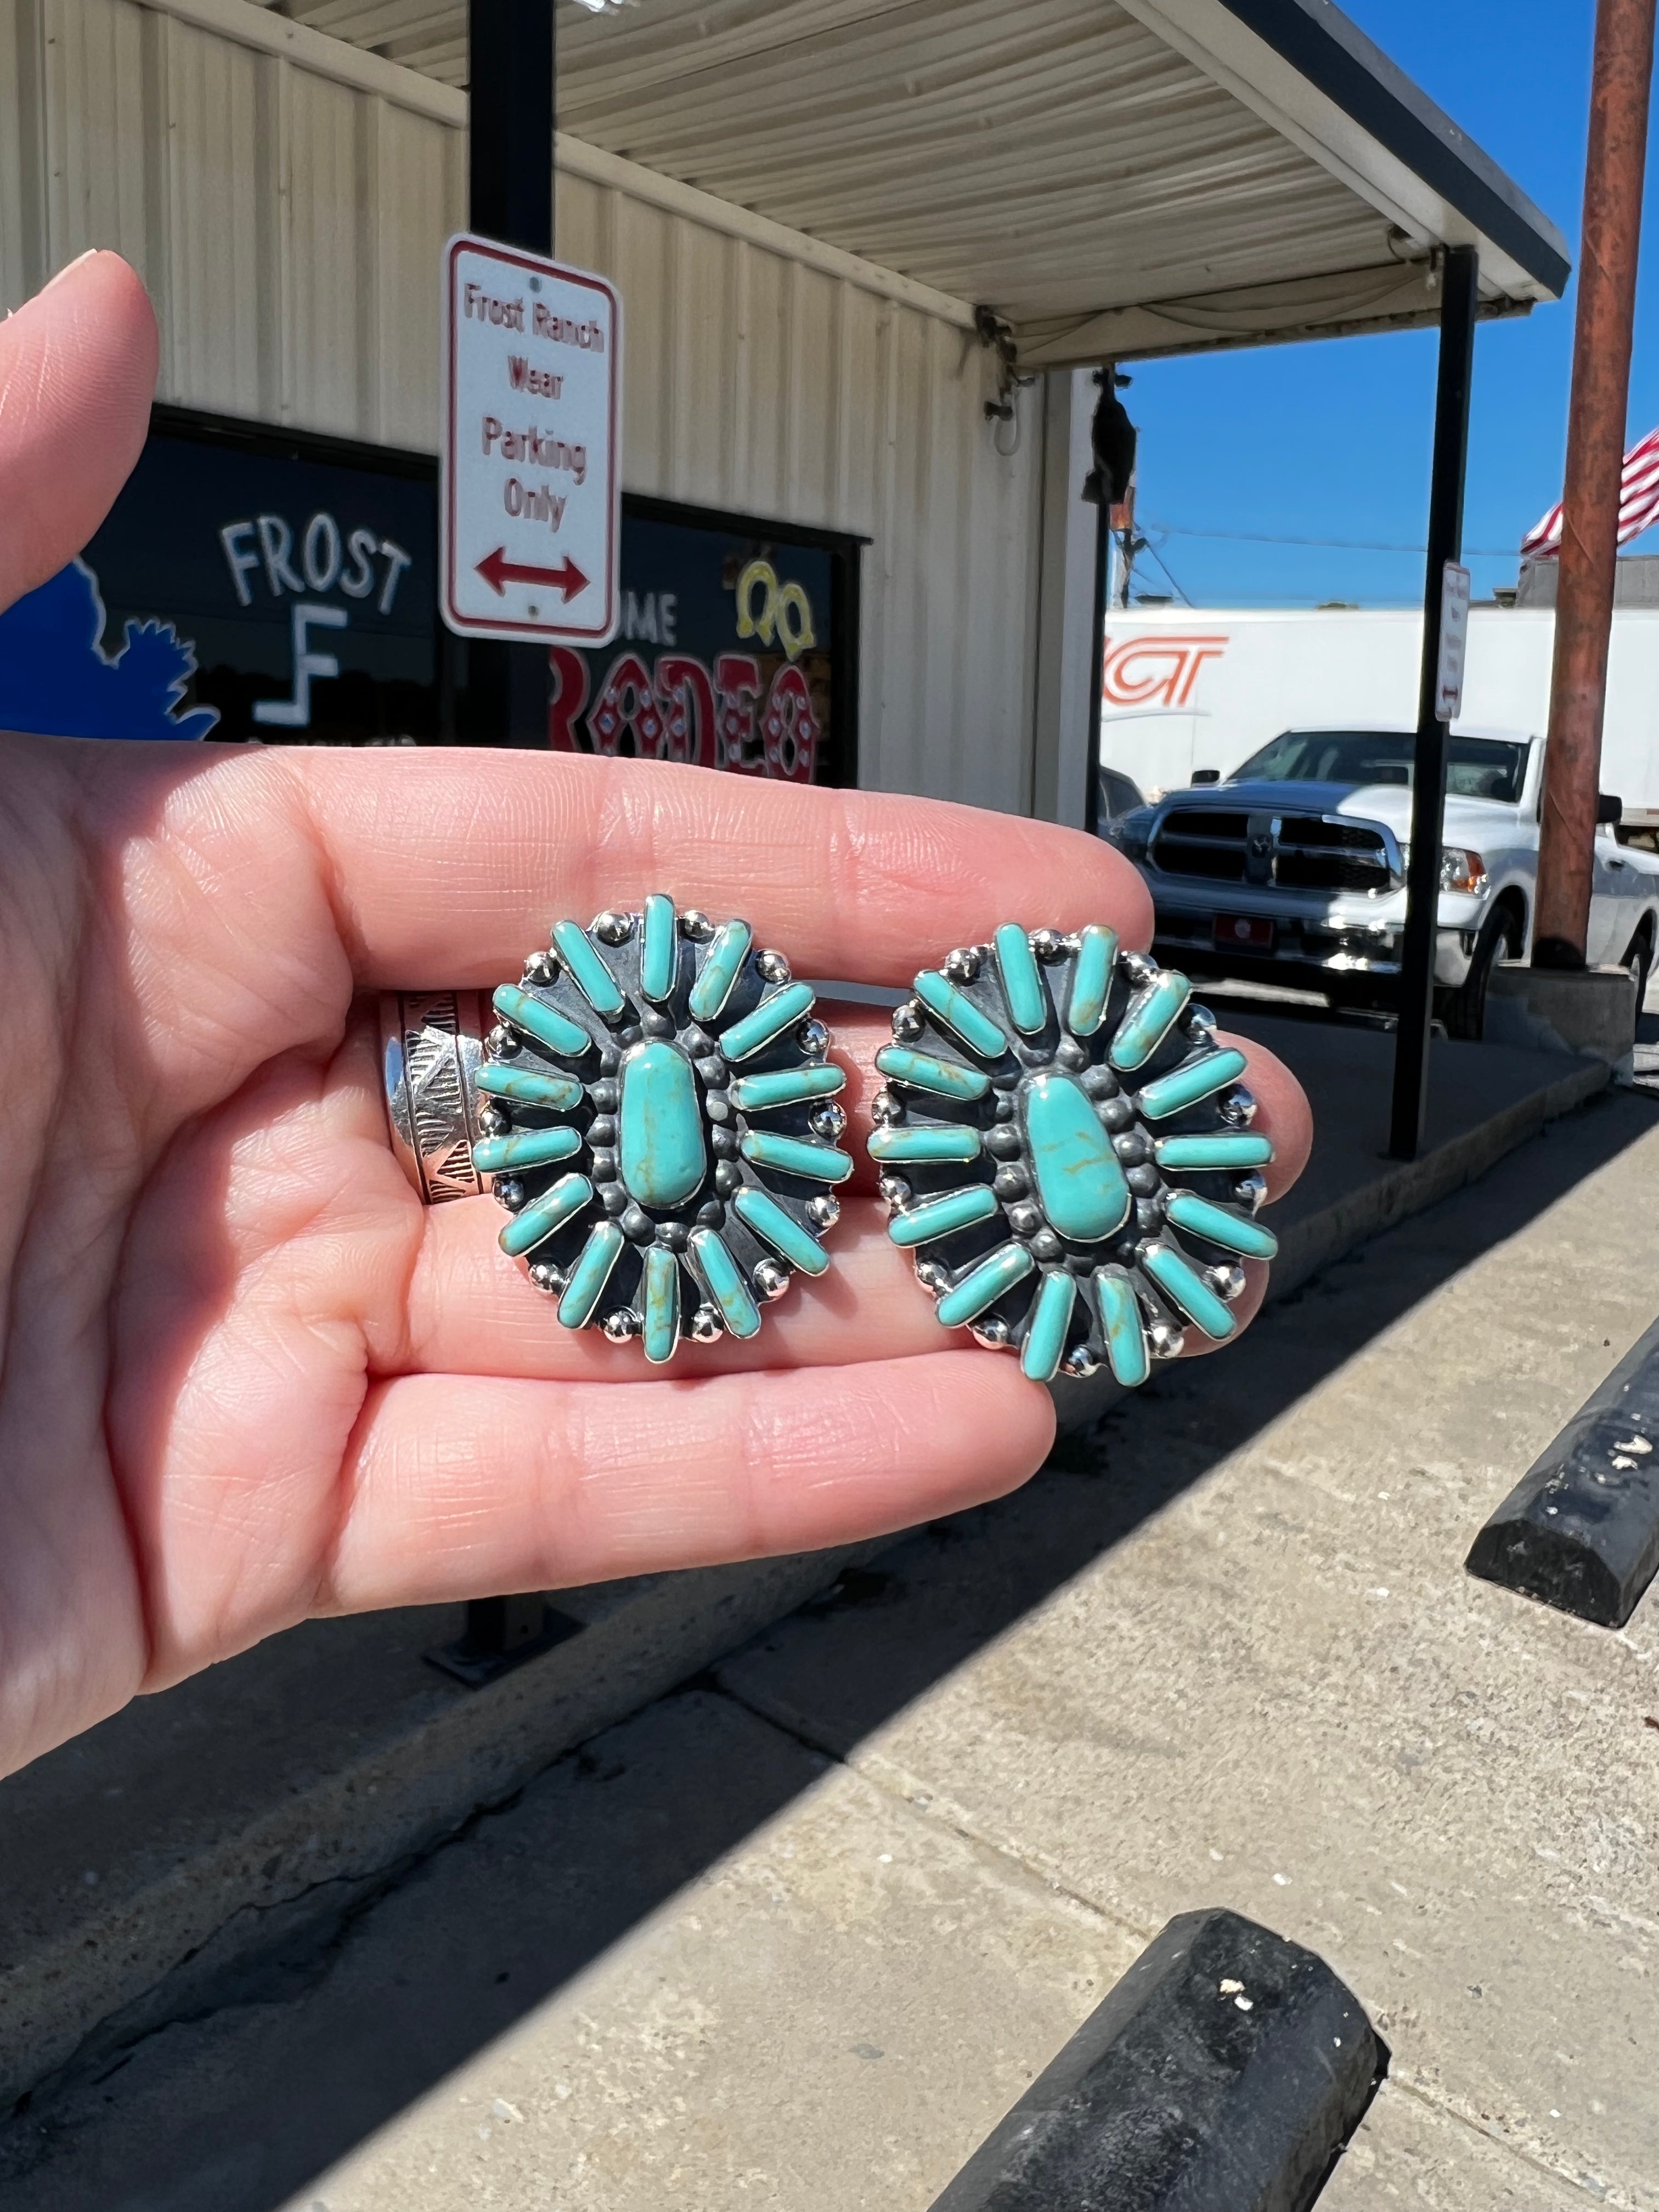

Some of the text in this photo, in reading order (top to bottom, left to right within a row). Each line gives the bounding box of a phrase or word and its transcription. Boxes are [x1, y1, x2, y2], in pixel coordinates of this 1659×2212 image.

[465, 283, 604, 352] Frost Ranch
[507, 355, 563, 399] Wear
[482, 416, 586, 486] Parking
[504, 478, 567, 533] Only
[222, 513, 412, 614] FROST
